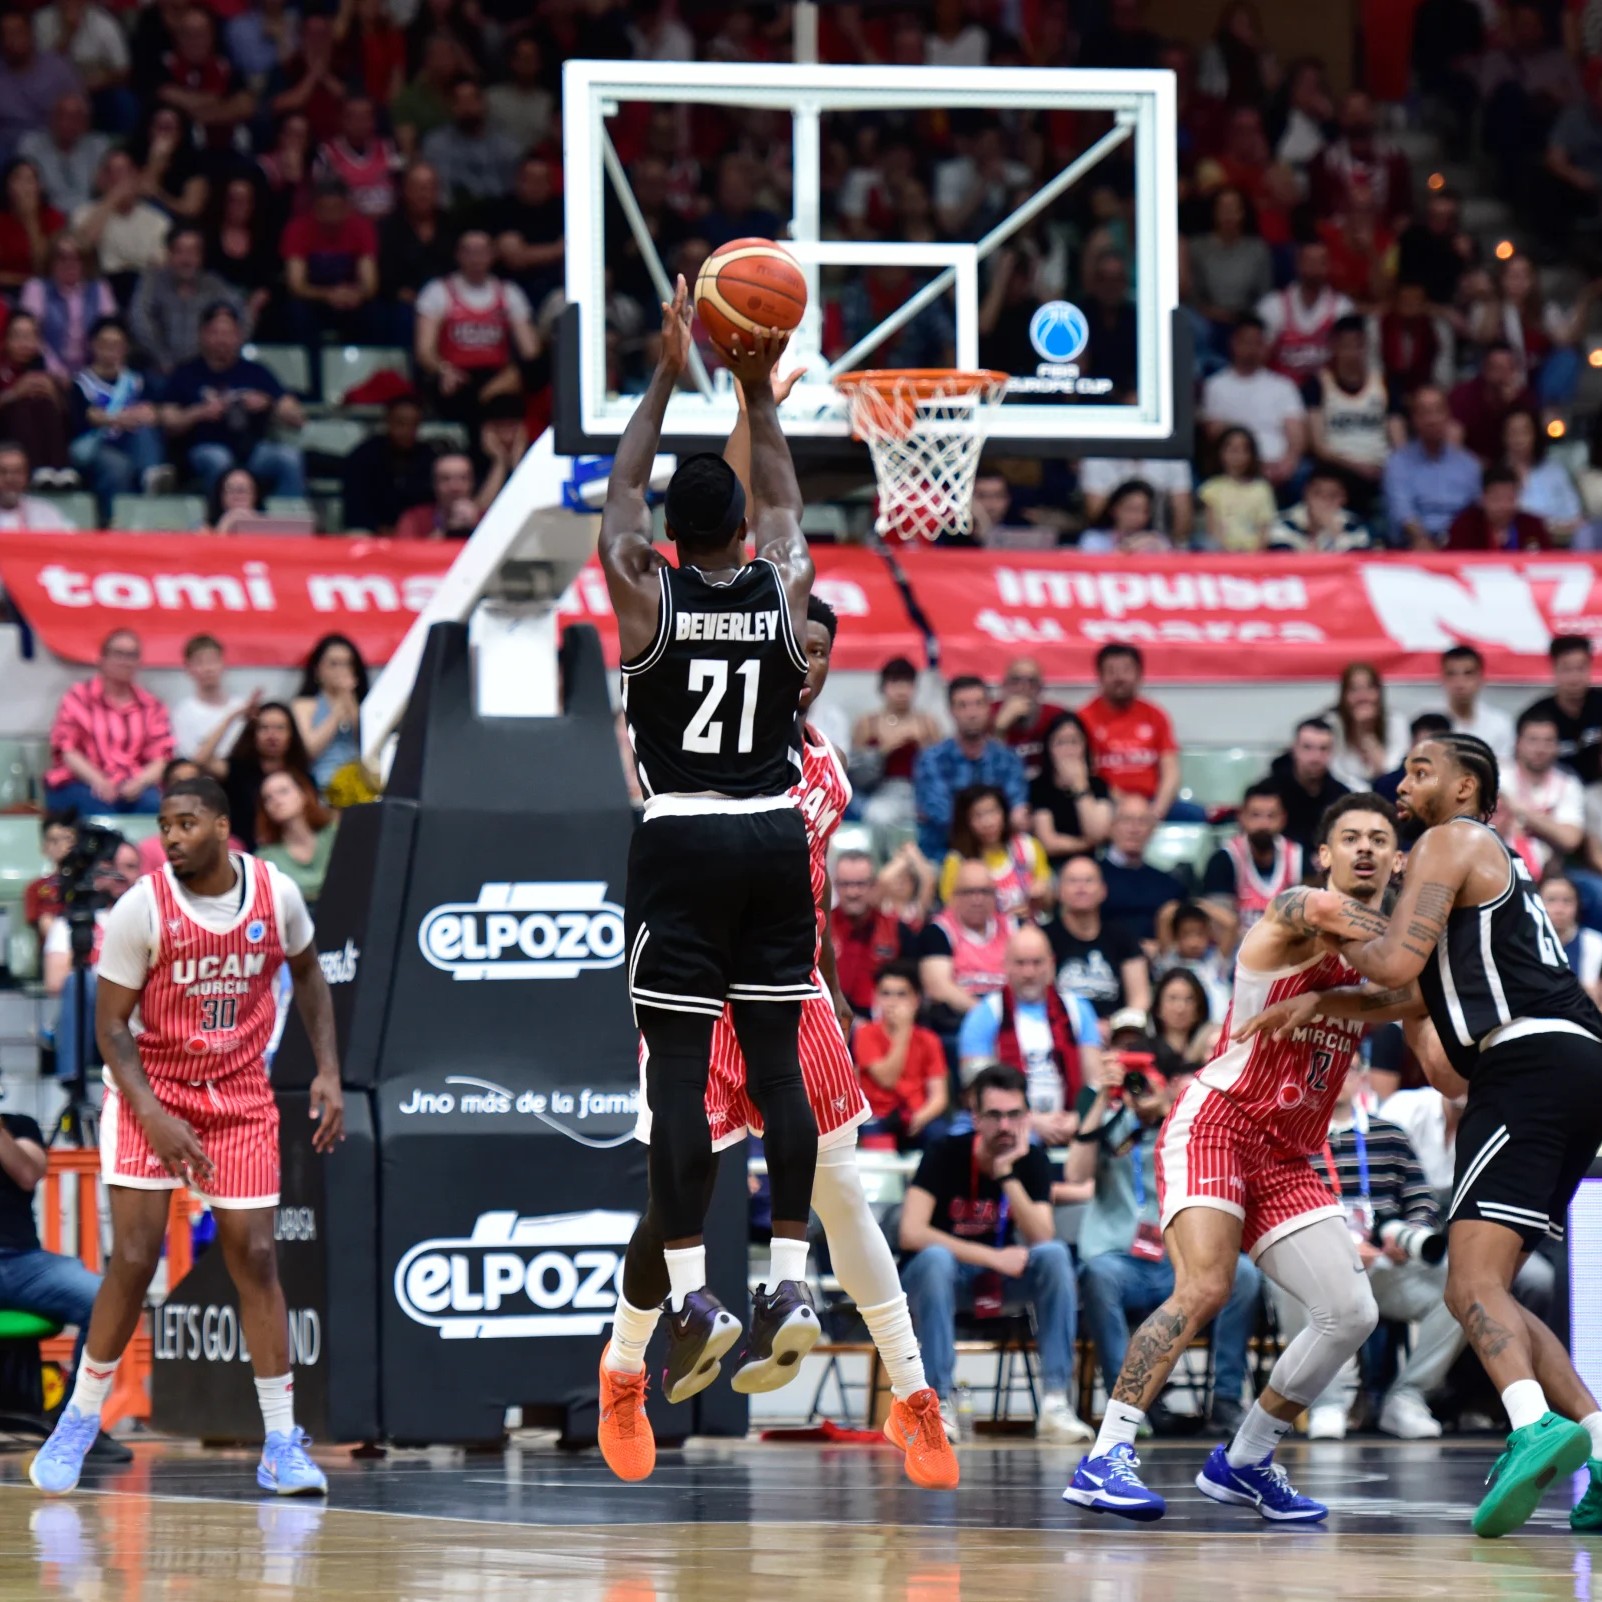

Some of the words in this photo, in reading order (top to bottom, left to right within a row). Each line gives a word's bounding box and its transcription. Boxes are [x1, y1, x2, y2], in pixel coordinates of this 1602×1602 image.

[38, 561, 276, 611] tomi
[675, 610, 779, 641] BEVERLEY
[682, 659, 760, 753] 21
[173, 953, 267, 984] UCAM
[201, 998, 238, 1032] 30
[461, 1089, 511, 1114] más
[516, 1089, 547, 1114] de
[551, 1089, 574, 1114] la
[154, 1304, 201, 1361] LET'S
[202, 1304, 237, 1362] GO
